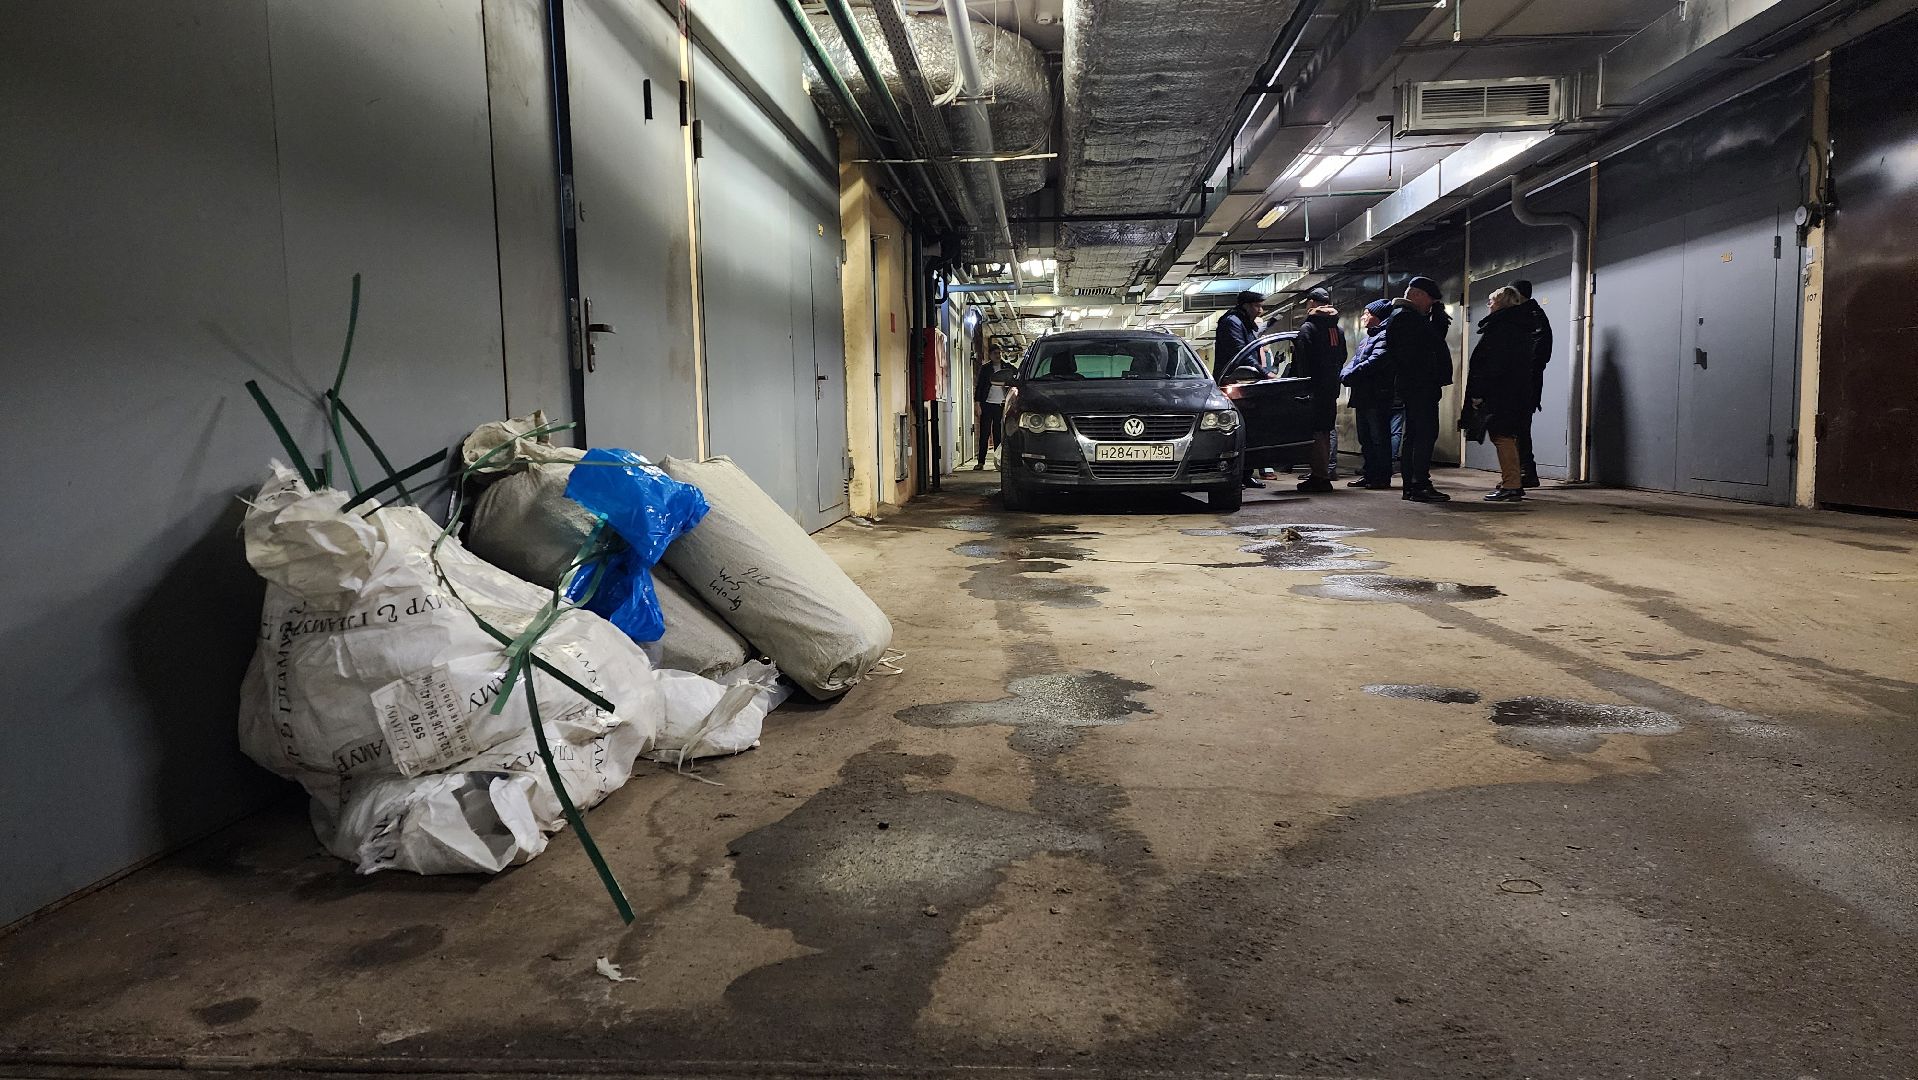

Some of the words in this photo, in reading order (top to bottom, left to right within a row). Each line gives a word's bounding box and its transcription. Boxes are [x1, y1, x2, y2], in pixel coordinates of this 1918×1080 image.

[1152, 446, 1170, 456] 750
[439, 682, 447, 693] 18
[420, 689, 430, 699] 42
